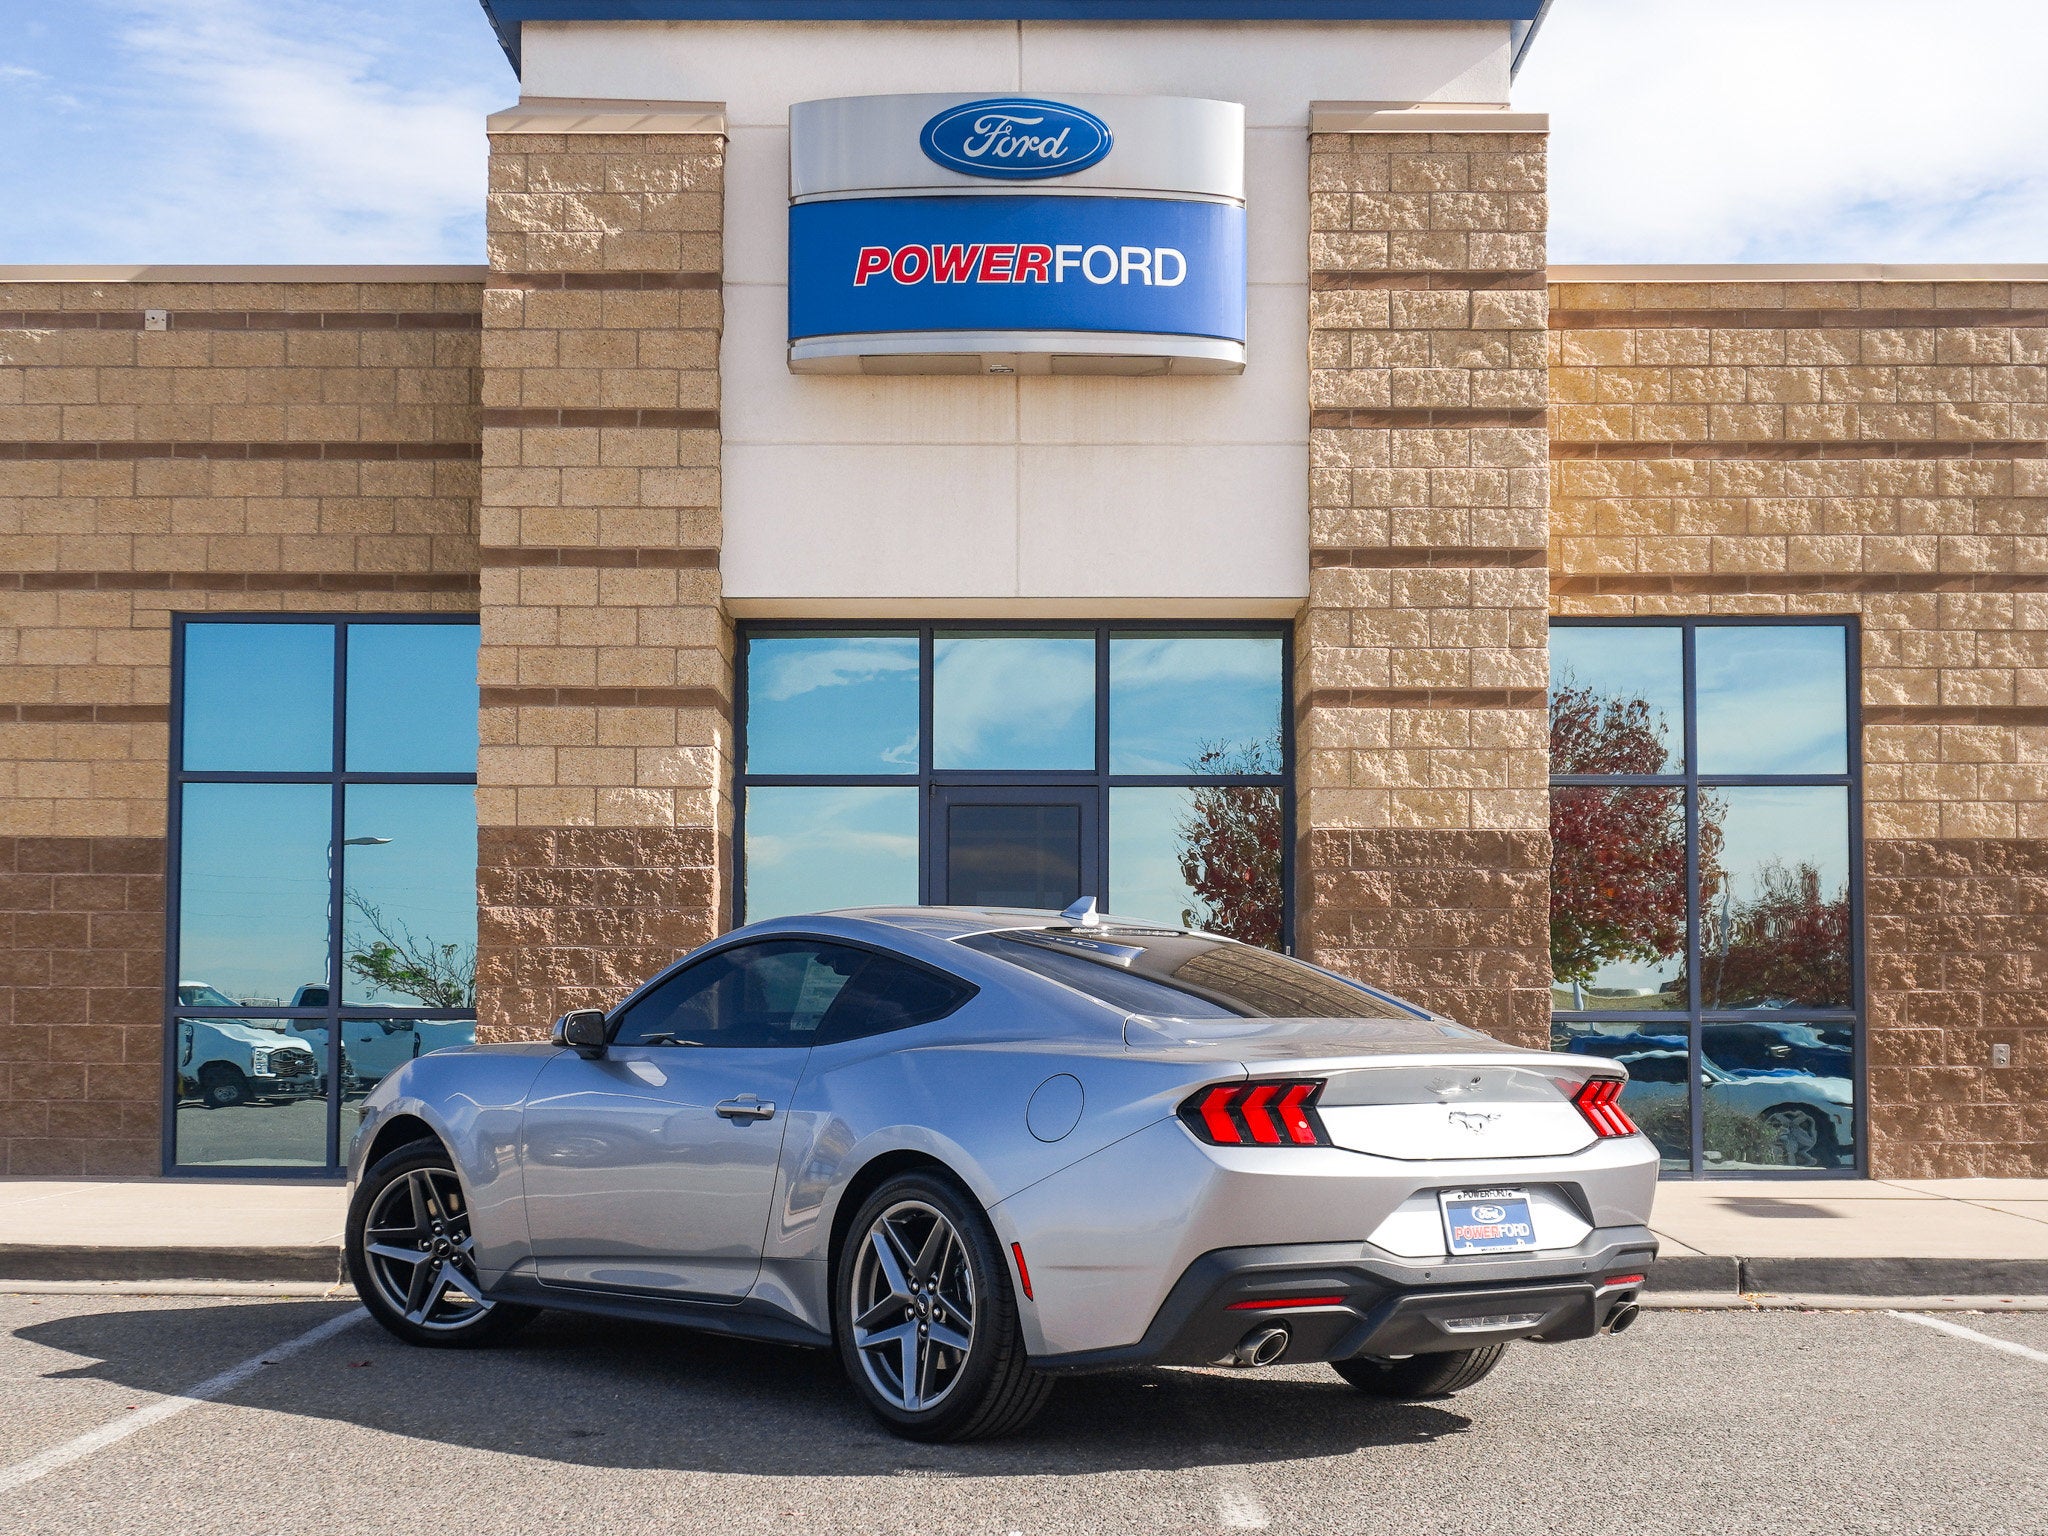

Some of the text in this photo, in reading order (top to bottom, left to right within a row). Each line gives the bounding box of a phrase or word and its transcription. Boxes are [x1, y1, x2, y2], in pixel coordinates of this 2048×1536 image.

[963, 114, 1070, 159] Ford
[853, 243, 1187, 287] POWERFORD
[1455, 1224, 1529, 1240] POWERFORD
